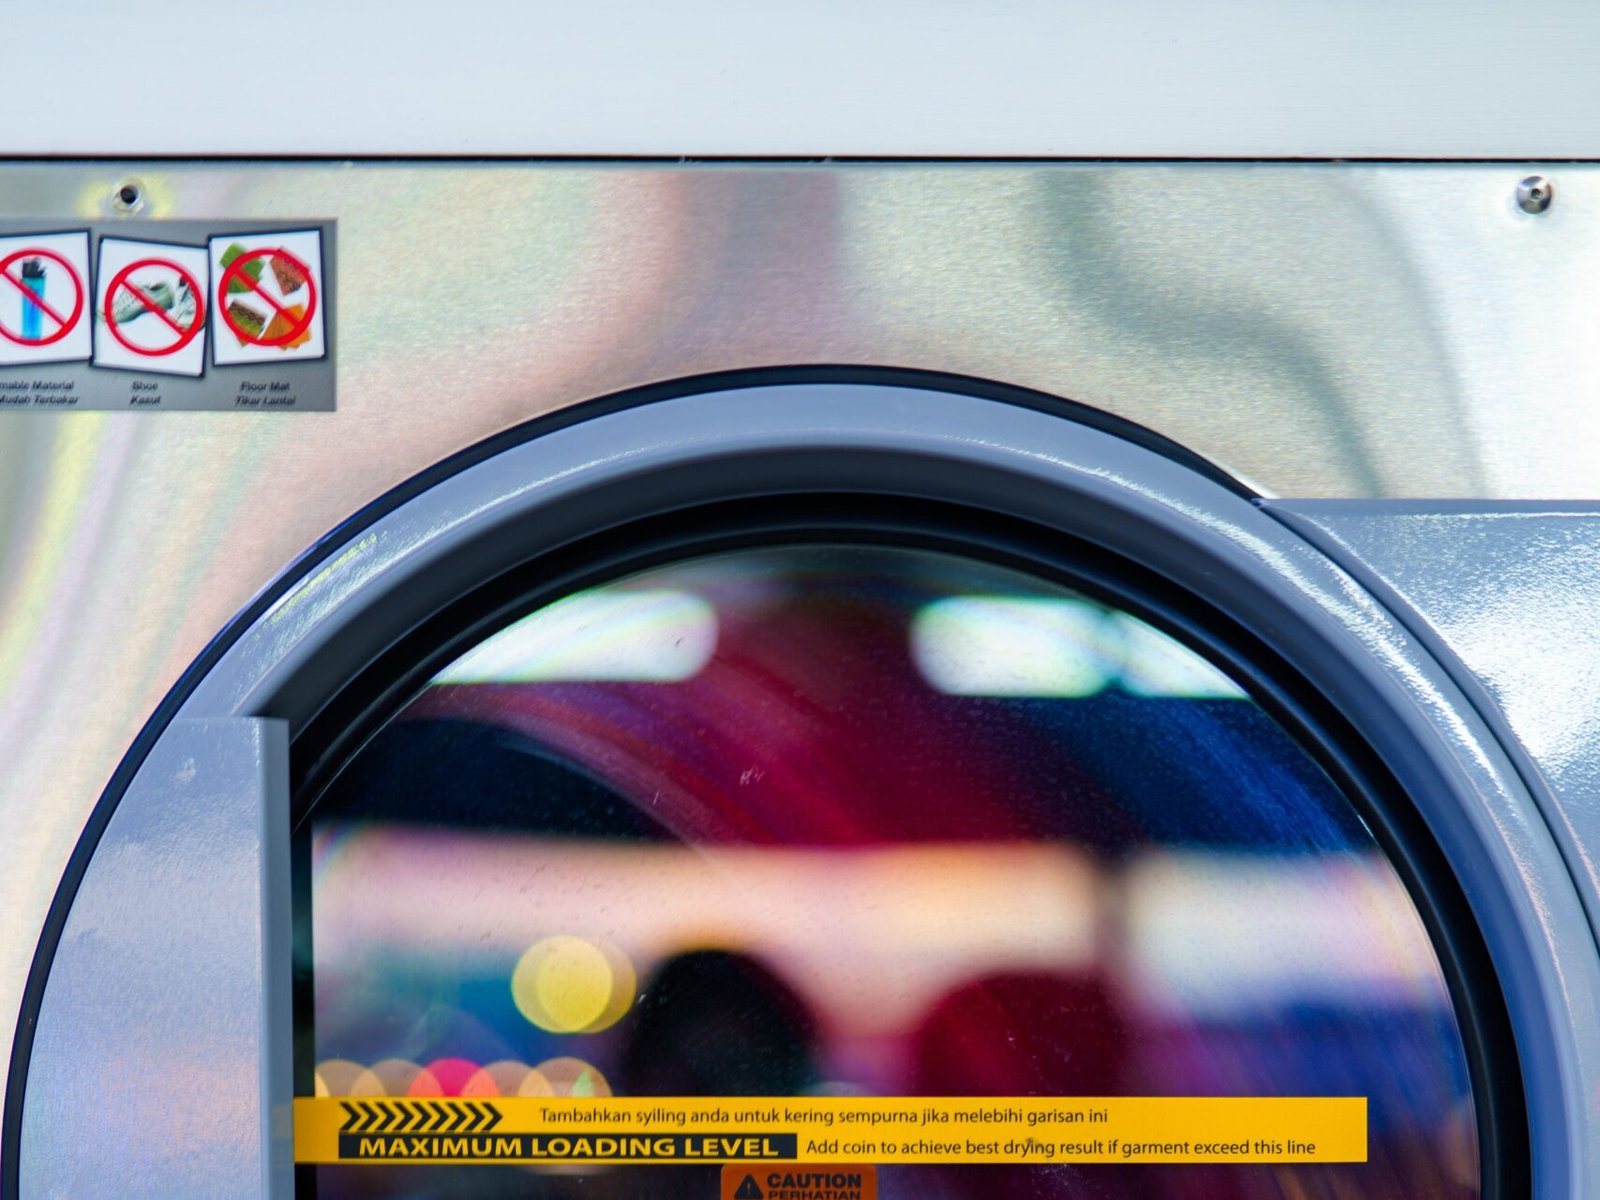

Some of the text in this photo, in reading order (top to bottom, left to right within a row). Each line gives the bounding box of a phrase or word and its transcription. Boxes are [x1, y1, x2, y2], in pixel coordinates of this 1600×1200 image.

[240, 382, 290, 392] Floor Mat
[541, 1108, 1107, 1127] Tambahkan syiling anda untuk kering sempurna jika melebihi garisan ini
[359, 1137, 779, 1156] MAXIMUM LOADING LEVEL
[807, 1139, 1315, 1159] Add coin to achieve best drying result if garment exceed this line
[767, 1173, 862, 1189] CAUTION
[768, 1190, 861, 1200] PERHATIAN
